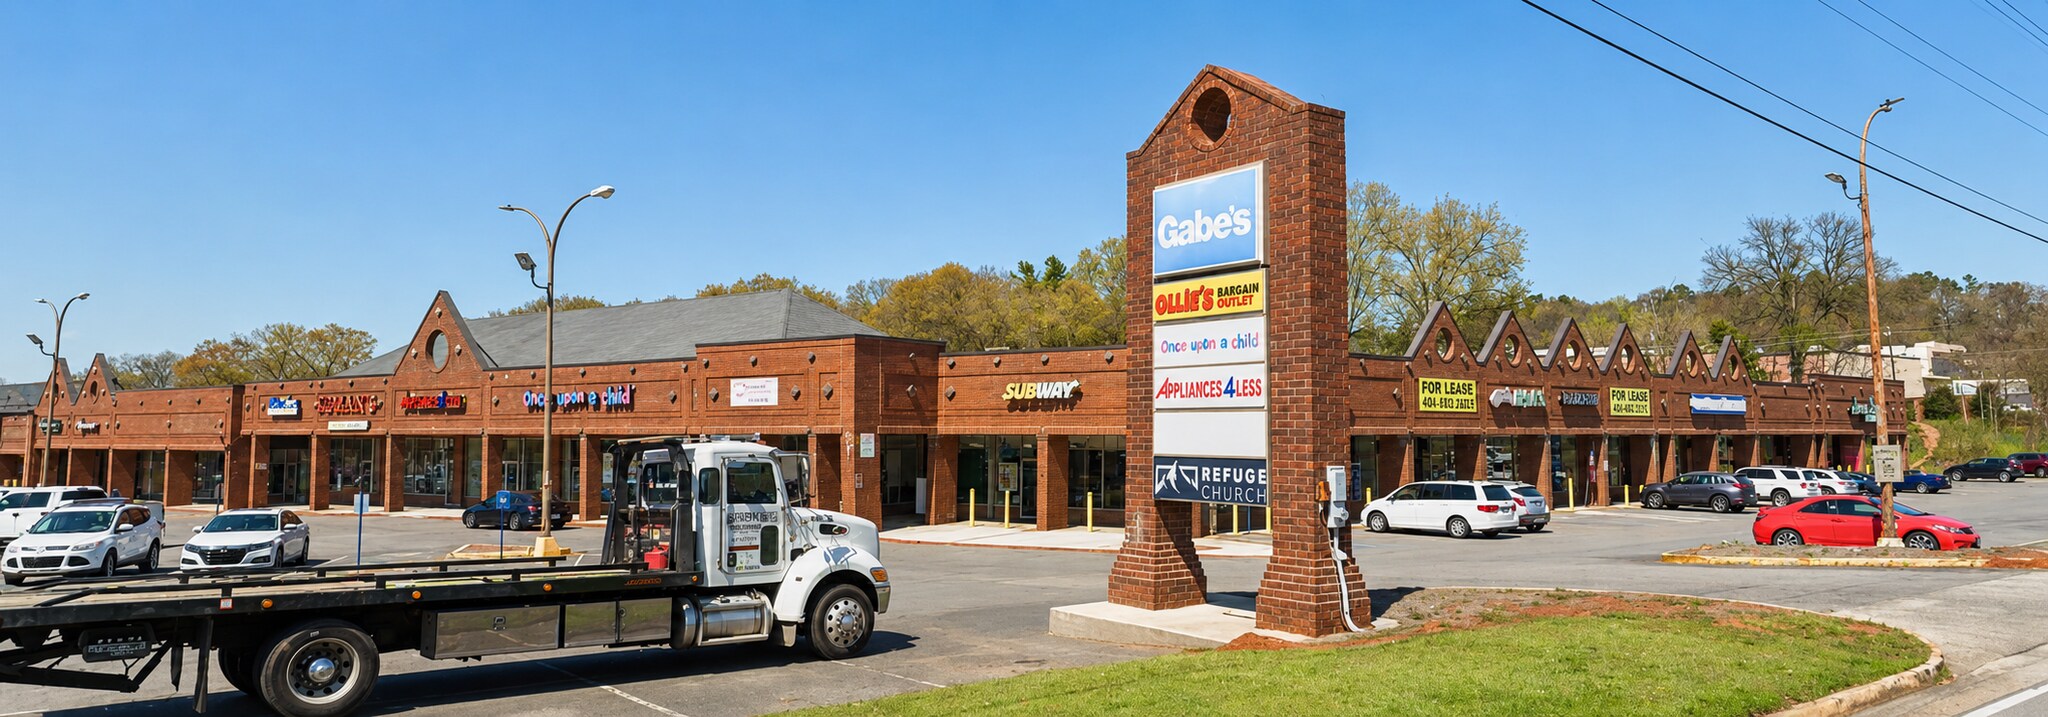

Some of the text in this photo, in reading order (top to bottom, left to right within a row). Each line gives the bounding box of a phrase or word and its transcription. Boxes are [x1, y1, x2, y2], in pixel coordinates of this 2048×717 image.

[1158, 205, 1252, 249] Gabe's
[1217, 282, 1260, 298] BARGAIN
[1155, 285, 1215, 316] OLLIE'S
[1217, 295, 1254, 309] OUTLET
[1161, 331, 1259, 354] Once upon a child
[1002, 379, 1080, 401] SUBWAY
[1421, 381, 1474, 395] FOR LEASE
[1612, 390, 1626, 401] FOR
[1627, 390, 1648, 402] LEASE
[557, 391, 585, 407] upon
[1201, 466, 1267, 485] REFUGE
[1201, 485, 1266, 503] CHURCH
